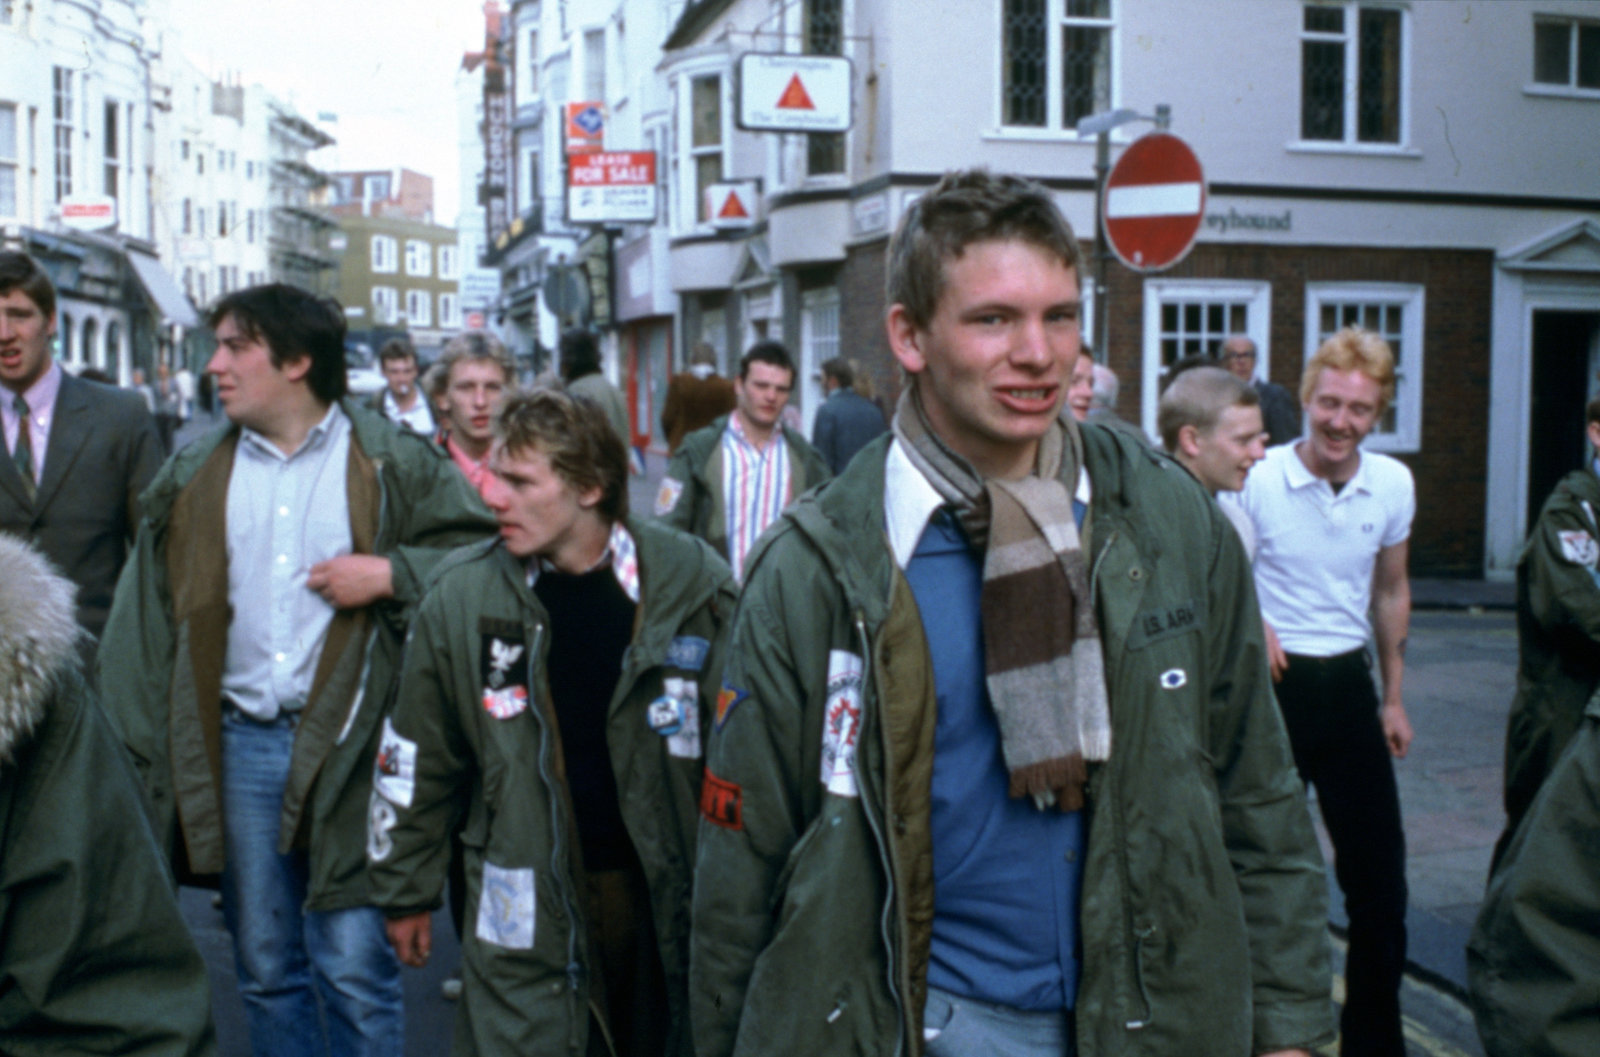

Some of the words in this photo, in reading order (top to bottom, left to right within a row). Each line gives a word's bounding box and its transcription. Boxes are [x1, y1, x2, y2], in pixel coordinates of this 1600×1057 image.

[573, 167, 604, 182] FOR
[609, 166, 648, 182] SALE
[1206, 206, 1292, 234] eyhound
